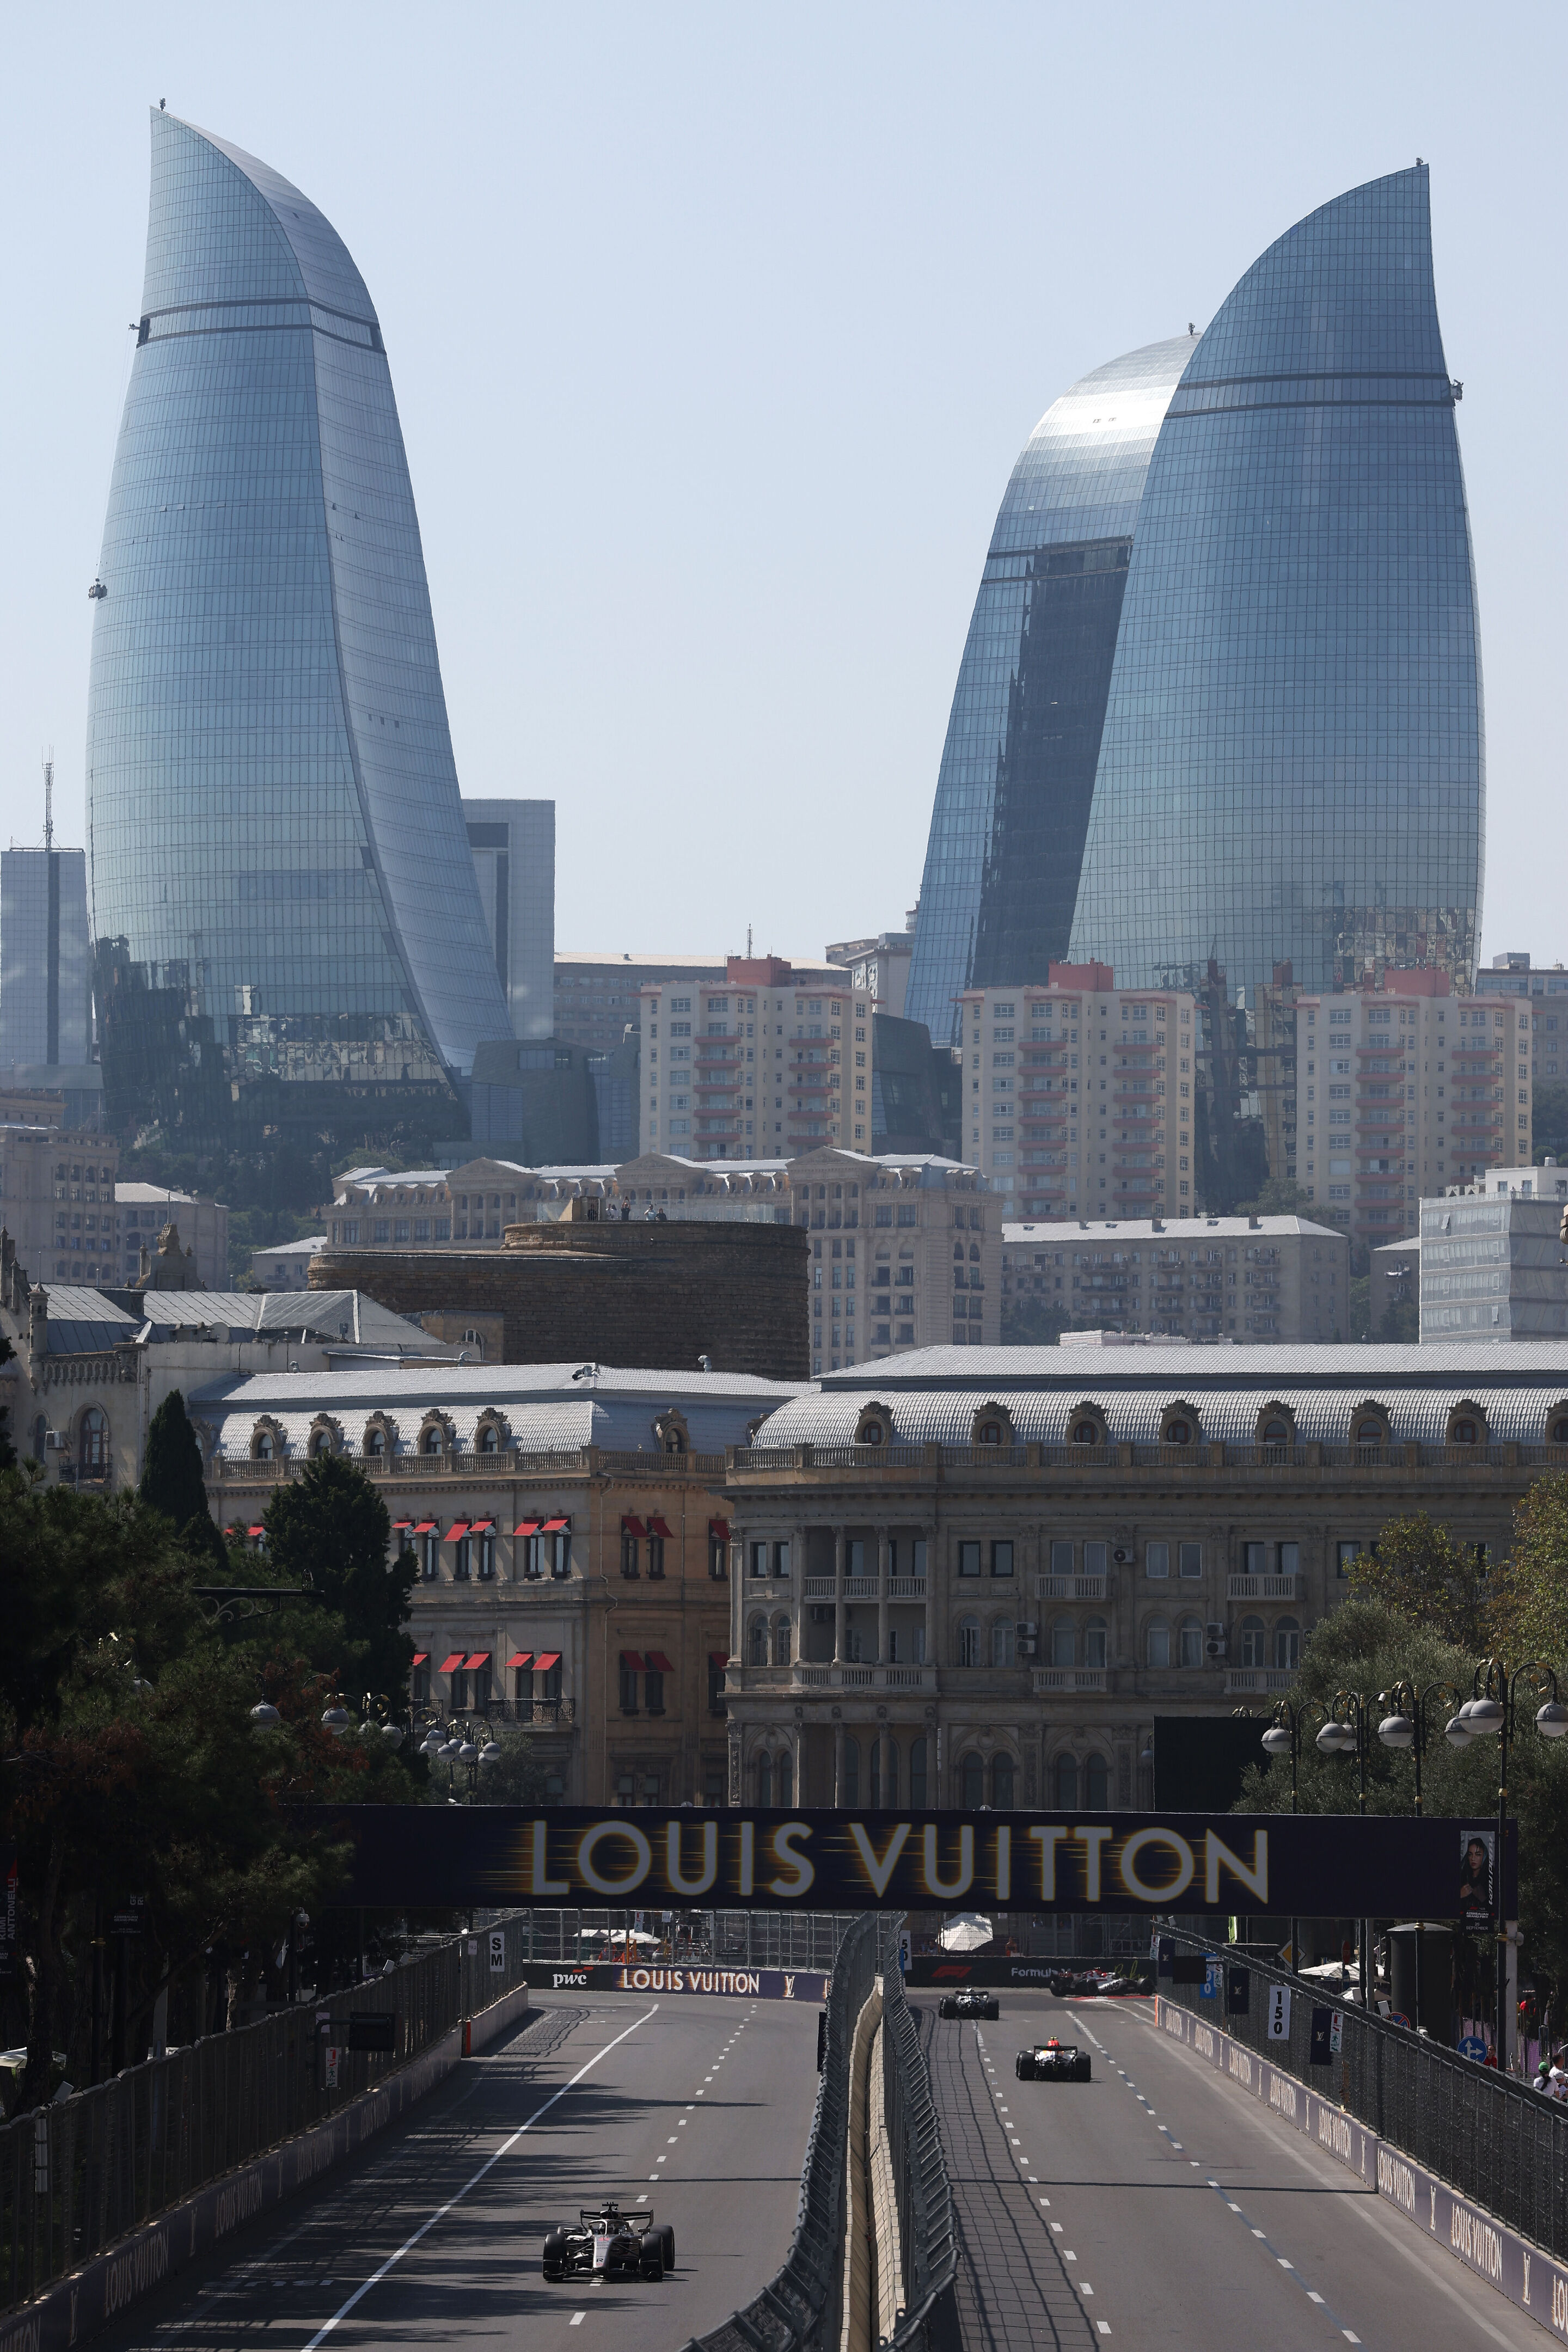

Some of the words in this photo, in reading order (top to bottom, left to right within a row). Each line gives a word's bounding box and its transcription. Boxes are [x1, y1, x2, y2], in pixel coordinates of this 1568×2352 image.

[532, 1820, 814, 1897] LOUIS
[850, 1823, 1269, 1904] VUITTON
[8, 1878, 16, 1940] ANTONELLI
[553, 1973, 587, 1988] pwc
[622, 1968, 684, 1991] LOUIS
[688, 1971, 761, 1994] VUITTON
[1273, 1991, 1283, 2035] 150
[1377, 2147, 1393, 2195] LOUIS
[1393, 2158, 1416, 2214] VUITTON
[105, 2252, 133, 2318] LOUIS
[134, 2225, 170, 2292] VUITTON
[1451, 2202, 1472, 2258] LOUIS
[1472, 2216, 1502, 2282] VUITTON
